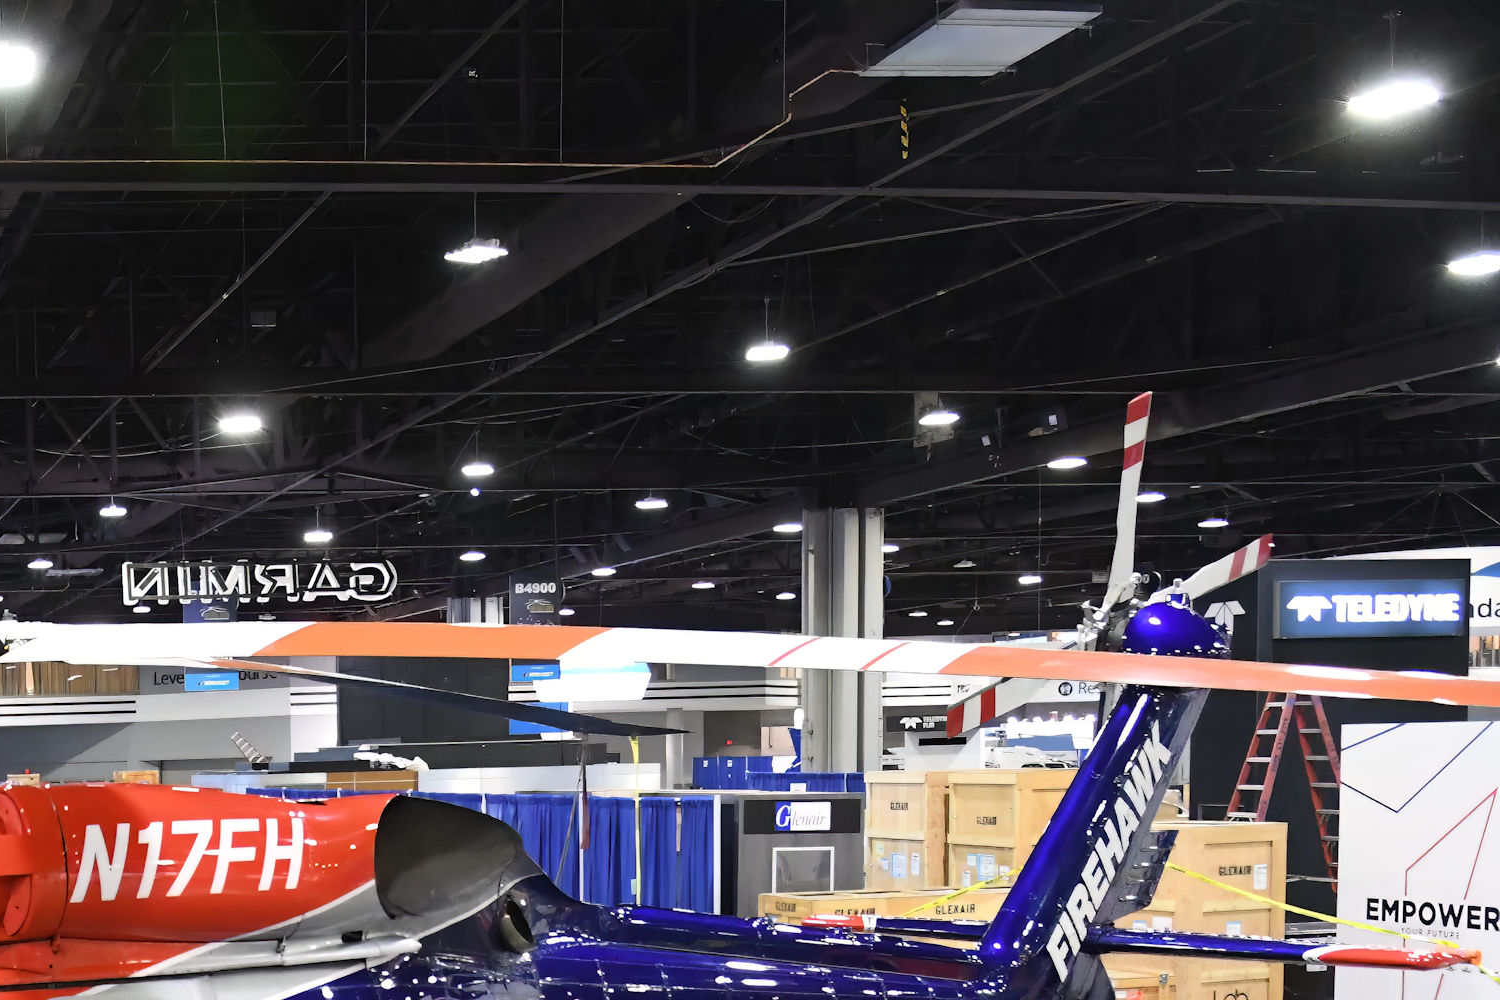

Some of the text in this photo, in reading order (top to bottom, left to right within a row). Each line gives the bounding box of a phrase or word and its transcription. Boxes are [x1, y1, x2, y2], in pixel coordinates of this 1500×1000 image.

[514, 582, 557, 594] B4900
[1331, 592, 1461, 623] TELEDYNE
[775, 804, 826, 829] Glenair
[69, 818, 304, 904] N17FH
[1046, 719, 1172, 983] FIREHAWK
[1219, 866, 1253, 876] GLENAIR
[934, 903, 976, 915] GLENAIR
[1366, 897, 1500, 932] EMPOWER
[1401, 927, 1460, 940] YOUR FUTURE
